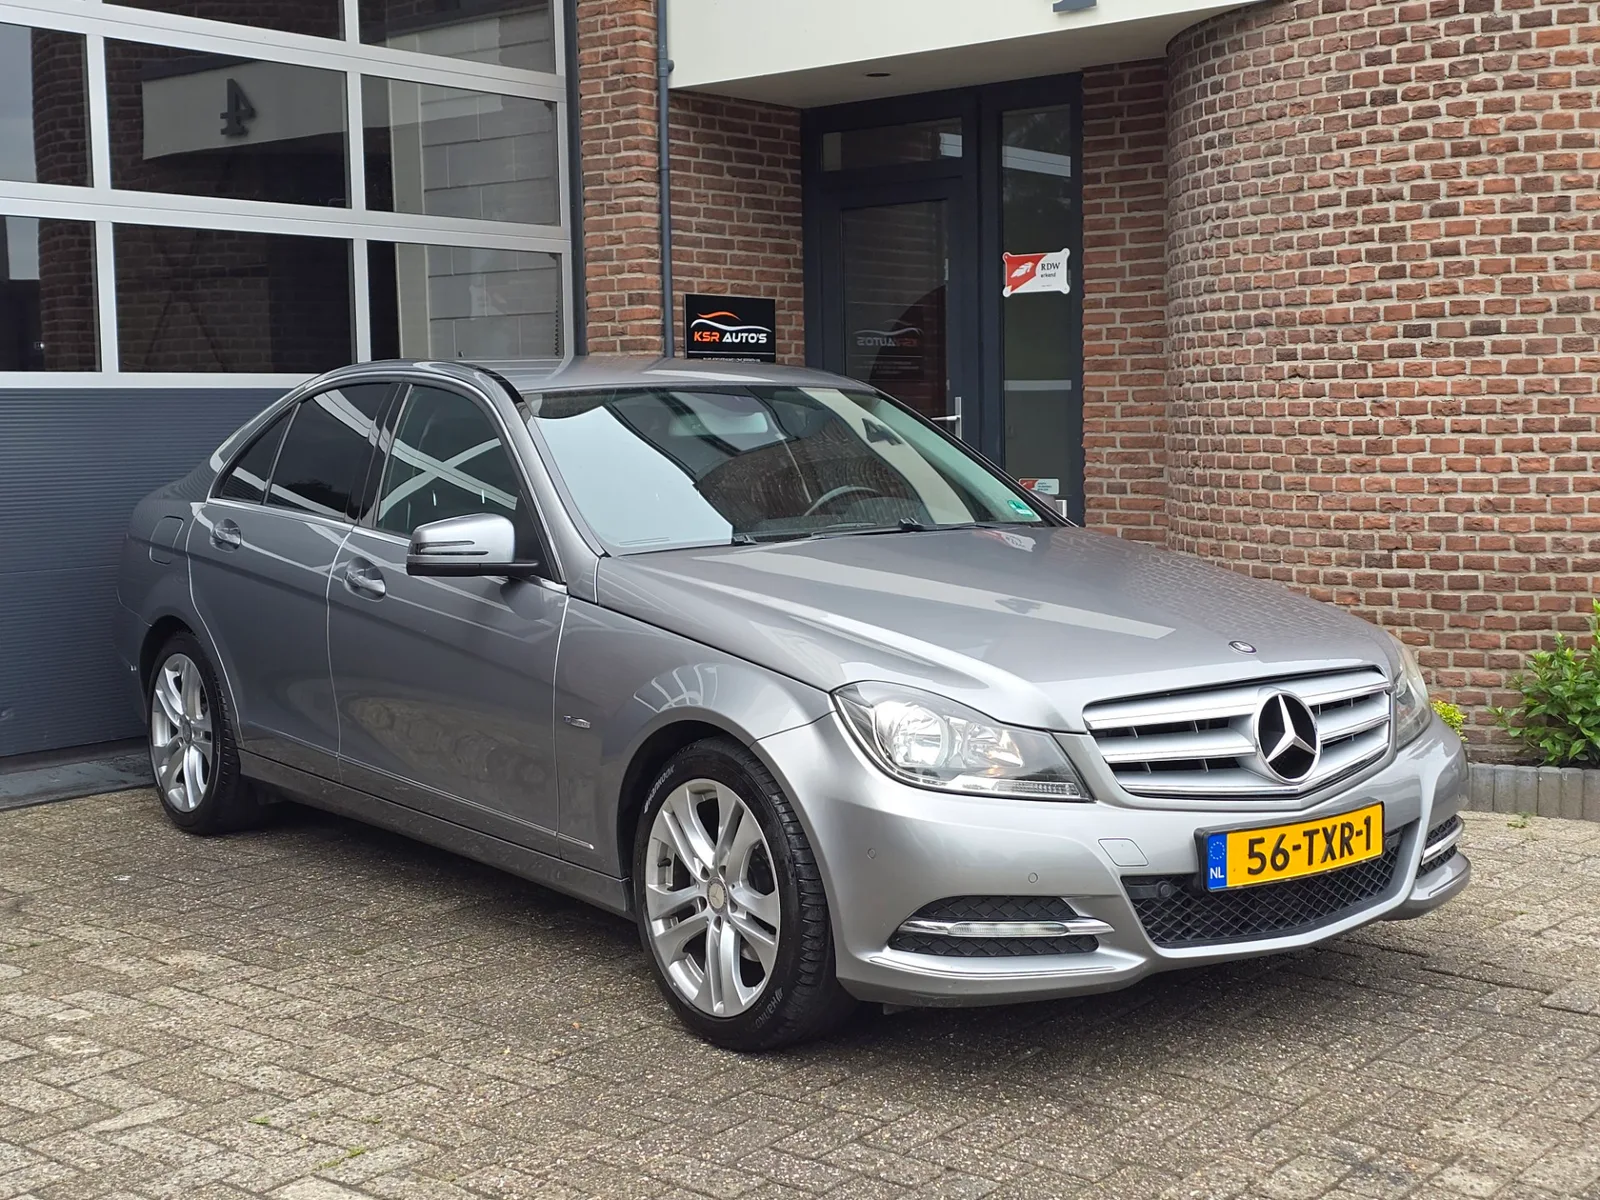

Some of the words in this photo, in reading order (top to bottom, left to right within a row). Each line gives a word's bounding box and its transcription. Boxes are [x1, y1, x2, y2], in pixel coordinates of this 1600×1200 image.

[1040, 261, 1061, 271] RDW
[693, 331, 720, 342] KSR
[722, 332, 767, 344] AUTO'S
[1209, 867, 1225, 880] NL
[1246, 815, 1372, 876] 56-TXR-1
